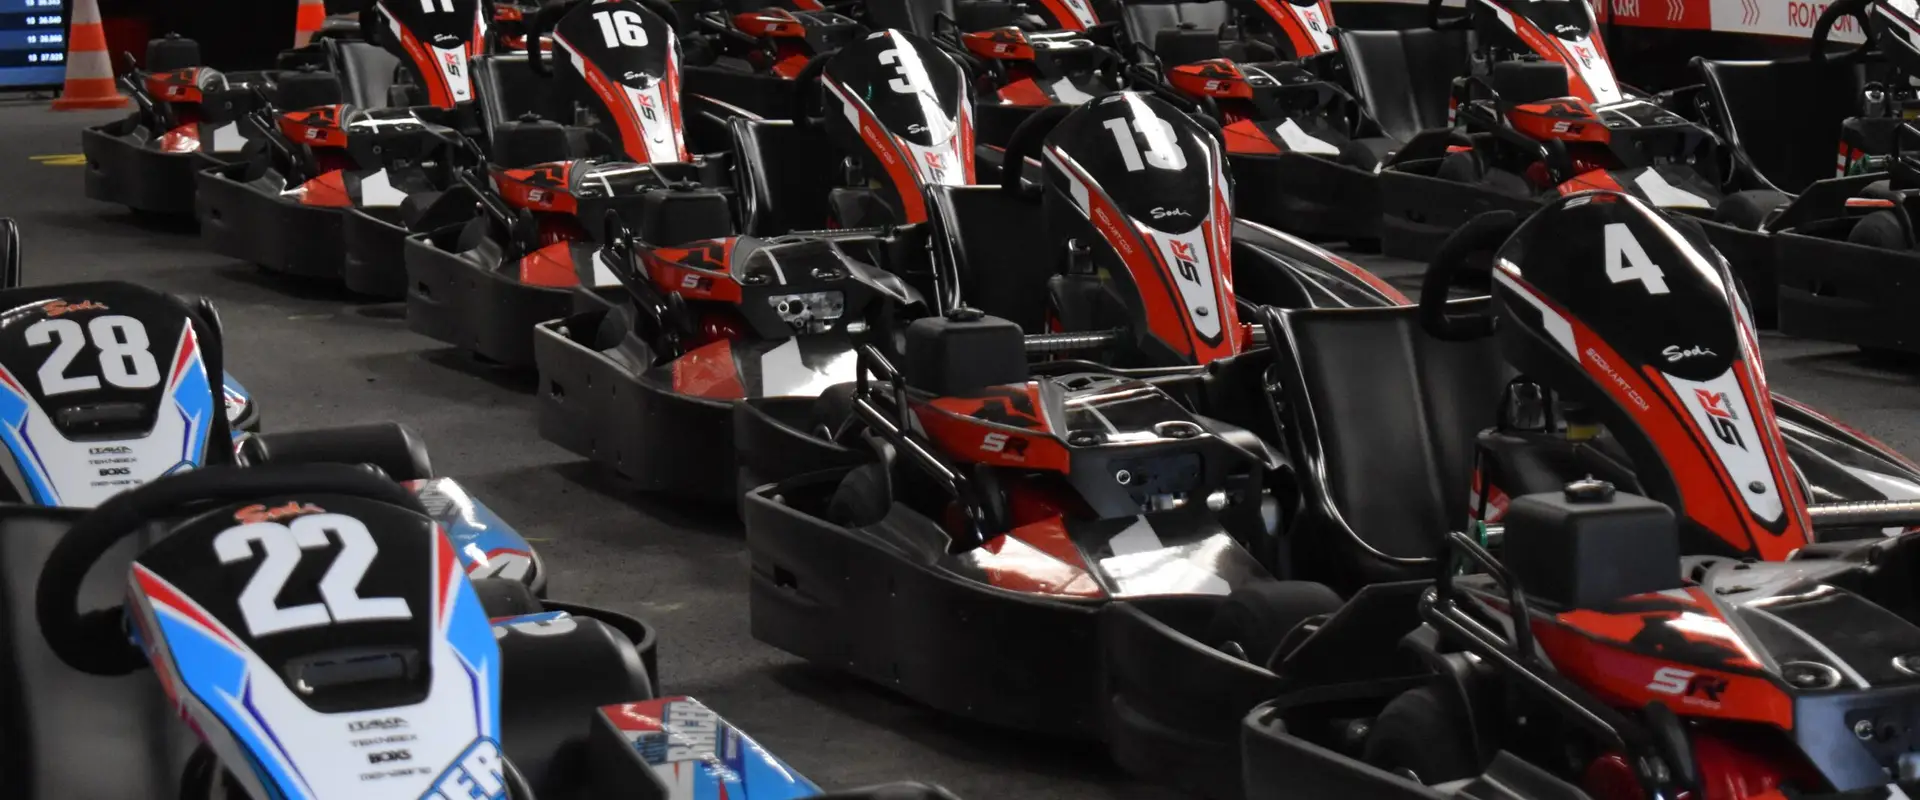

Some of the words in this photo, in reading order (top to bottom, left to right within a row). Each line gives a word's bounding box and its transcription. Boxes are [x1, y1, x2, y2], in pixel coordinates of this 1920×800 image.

[592, 10, 649, 48] 16
[1102, 116, 1188, 172] 13
[1168, 238, 1202, 288] SR
[1604, 222, 1671, 294] 4
[24, 314, 162, 397] 28
[1662, 344, 1719, 362] Sodi
[980, 432, 1030, 457] SR
[1693, 388, 1750, 453] SR
[212, 512, 413, 639] 22
[1646, 666, 1730, 703] SR
